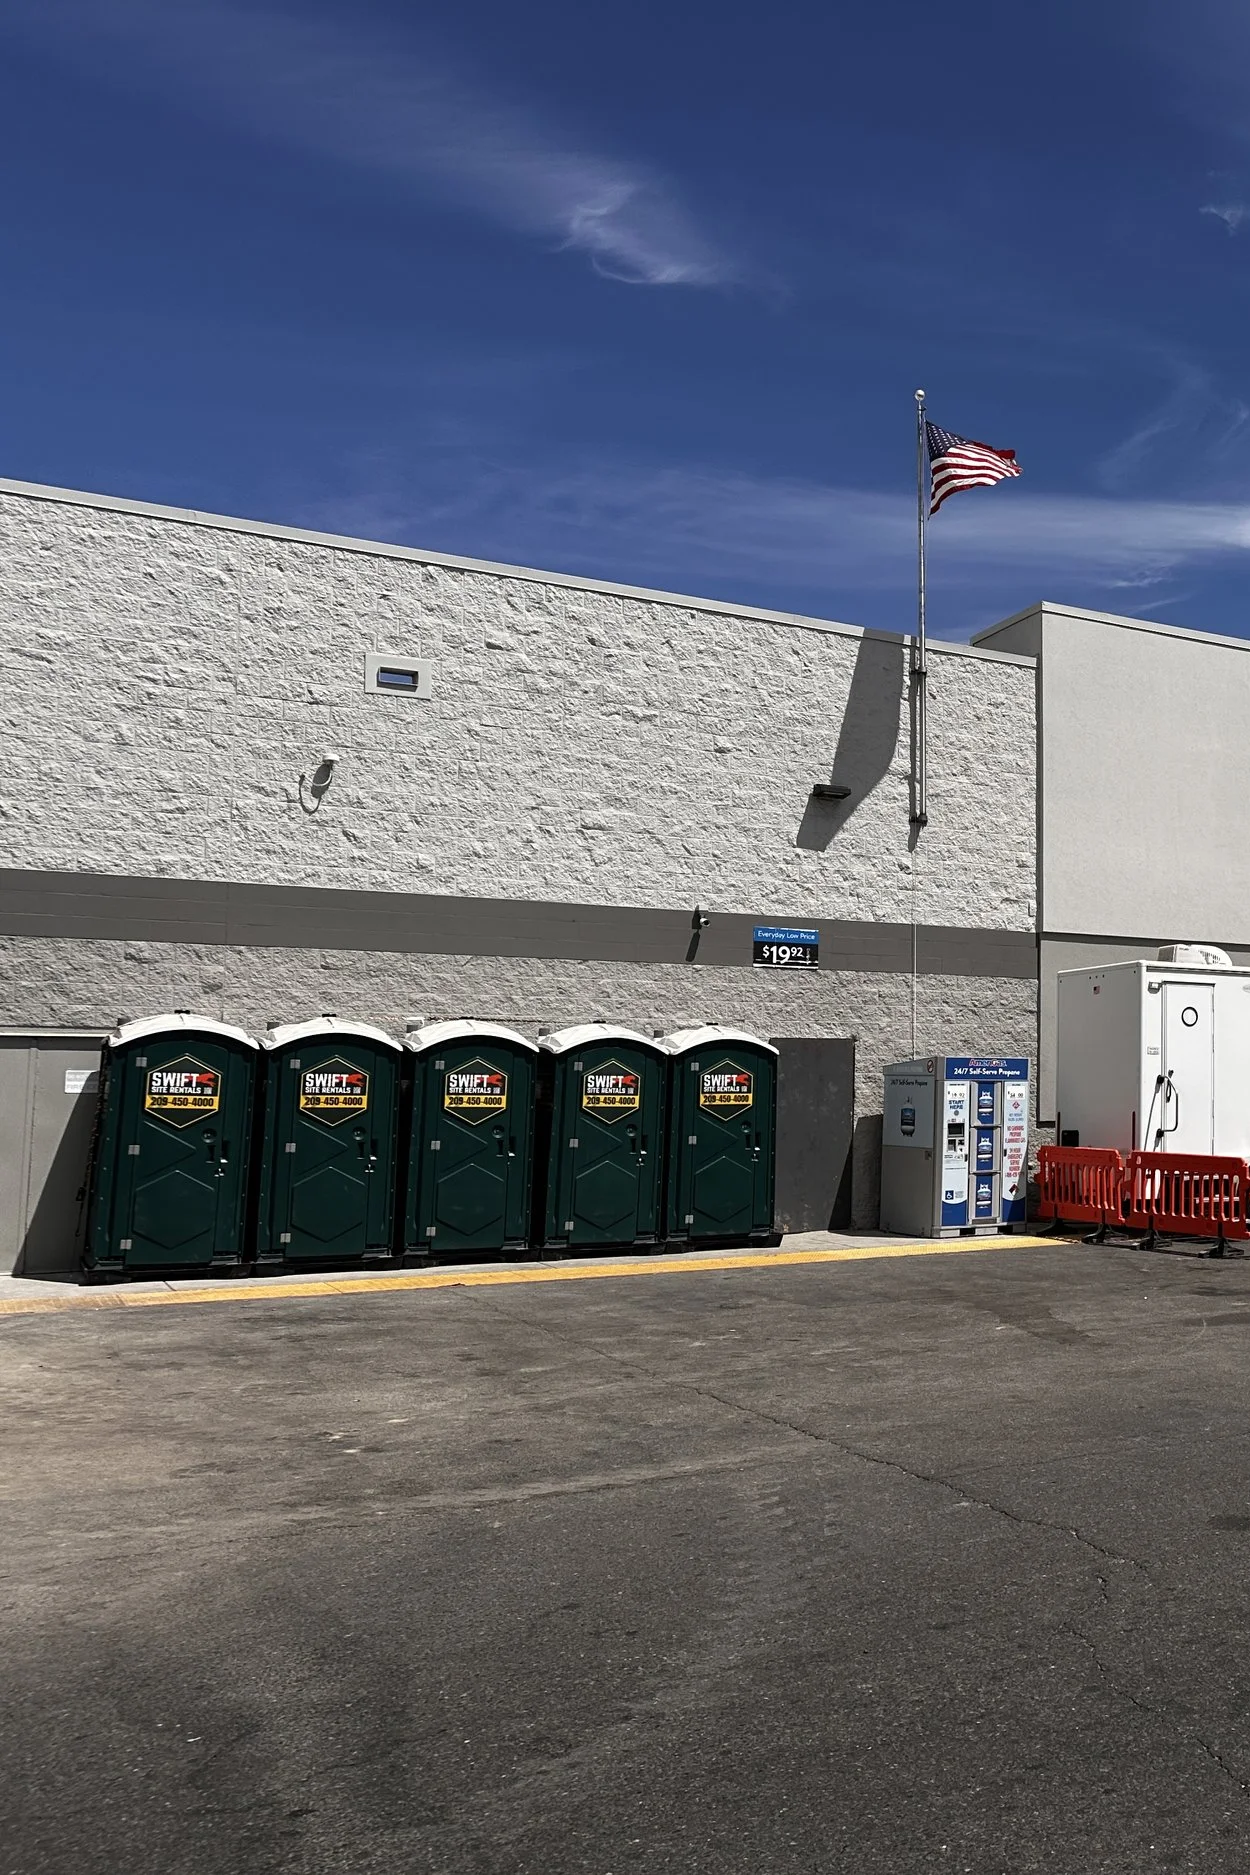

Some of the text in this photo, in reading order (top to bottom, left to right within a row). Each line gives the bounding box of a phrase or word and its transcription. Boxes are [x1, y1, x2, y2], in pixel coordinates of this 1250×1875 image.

[757, 930, 786, 940] Everyday
[800, 932, 816, 940] Price
[969, 1067, 998, 1075] Self-Serve
[998, 1067, 1021, 1077] Propane
[151, 1072, 200, 1087] SWIFT
[305, 1073, 349, 1087] SWIFT
[449, 1074, 489, 1088] SWIFT
[587, 1075, 624, 1088] SWIFT
[703, 1074, 738, 1087] SWIFT
[150, 1096, 214, 1107] 209-450-4000
[304, 1096, 363, 1106] 209-450-4000
[448, 1096, 503, 1106] 209-450-4000
[586, 1096, 636, 1105] 209-450-4000
